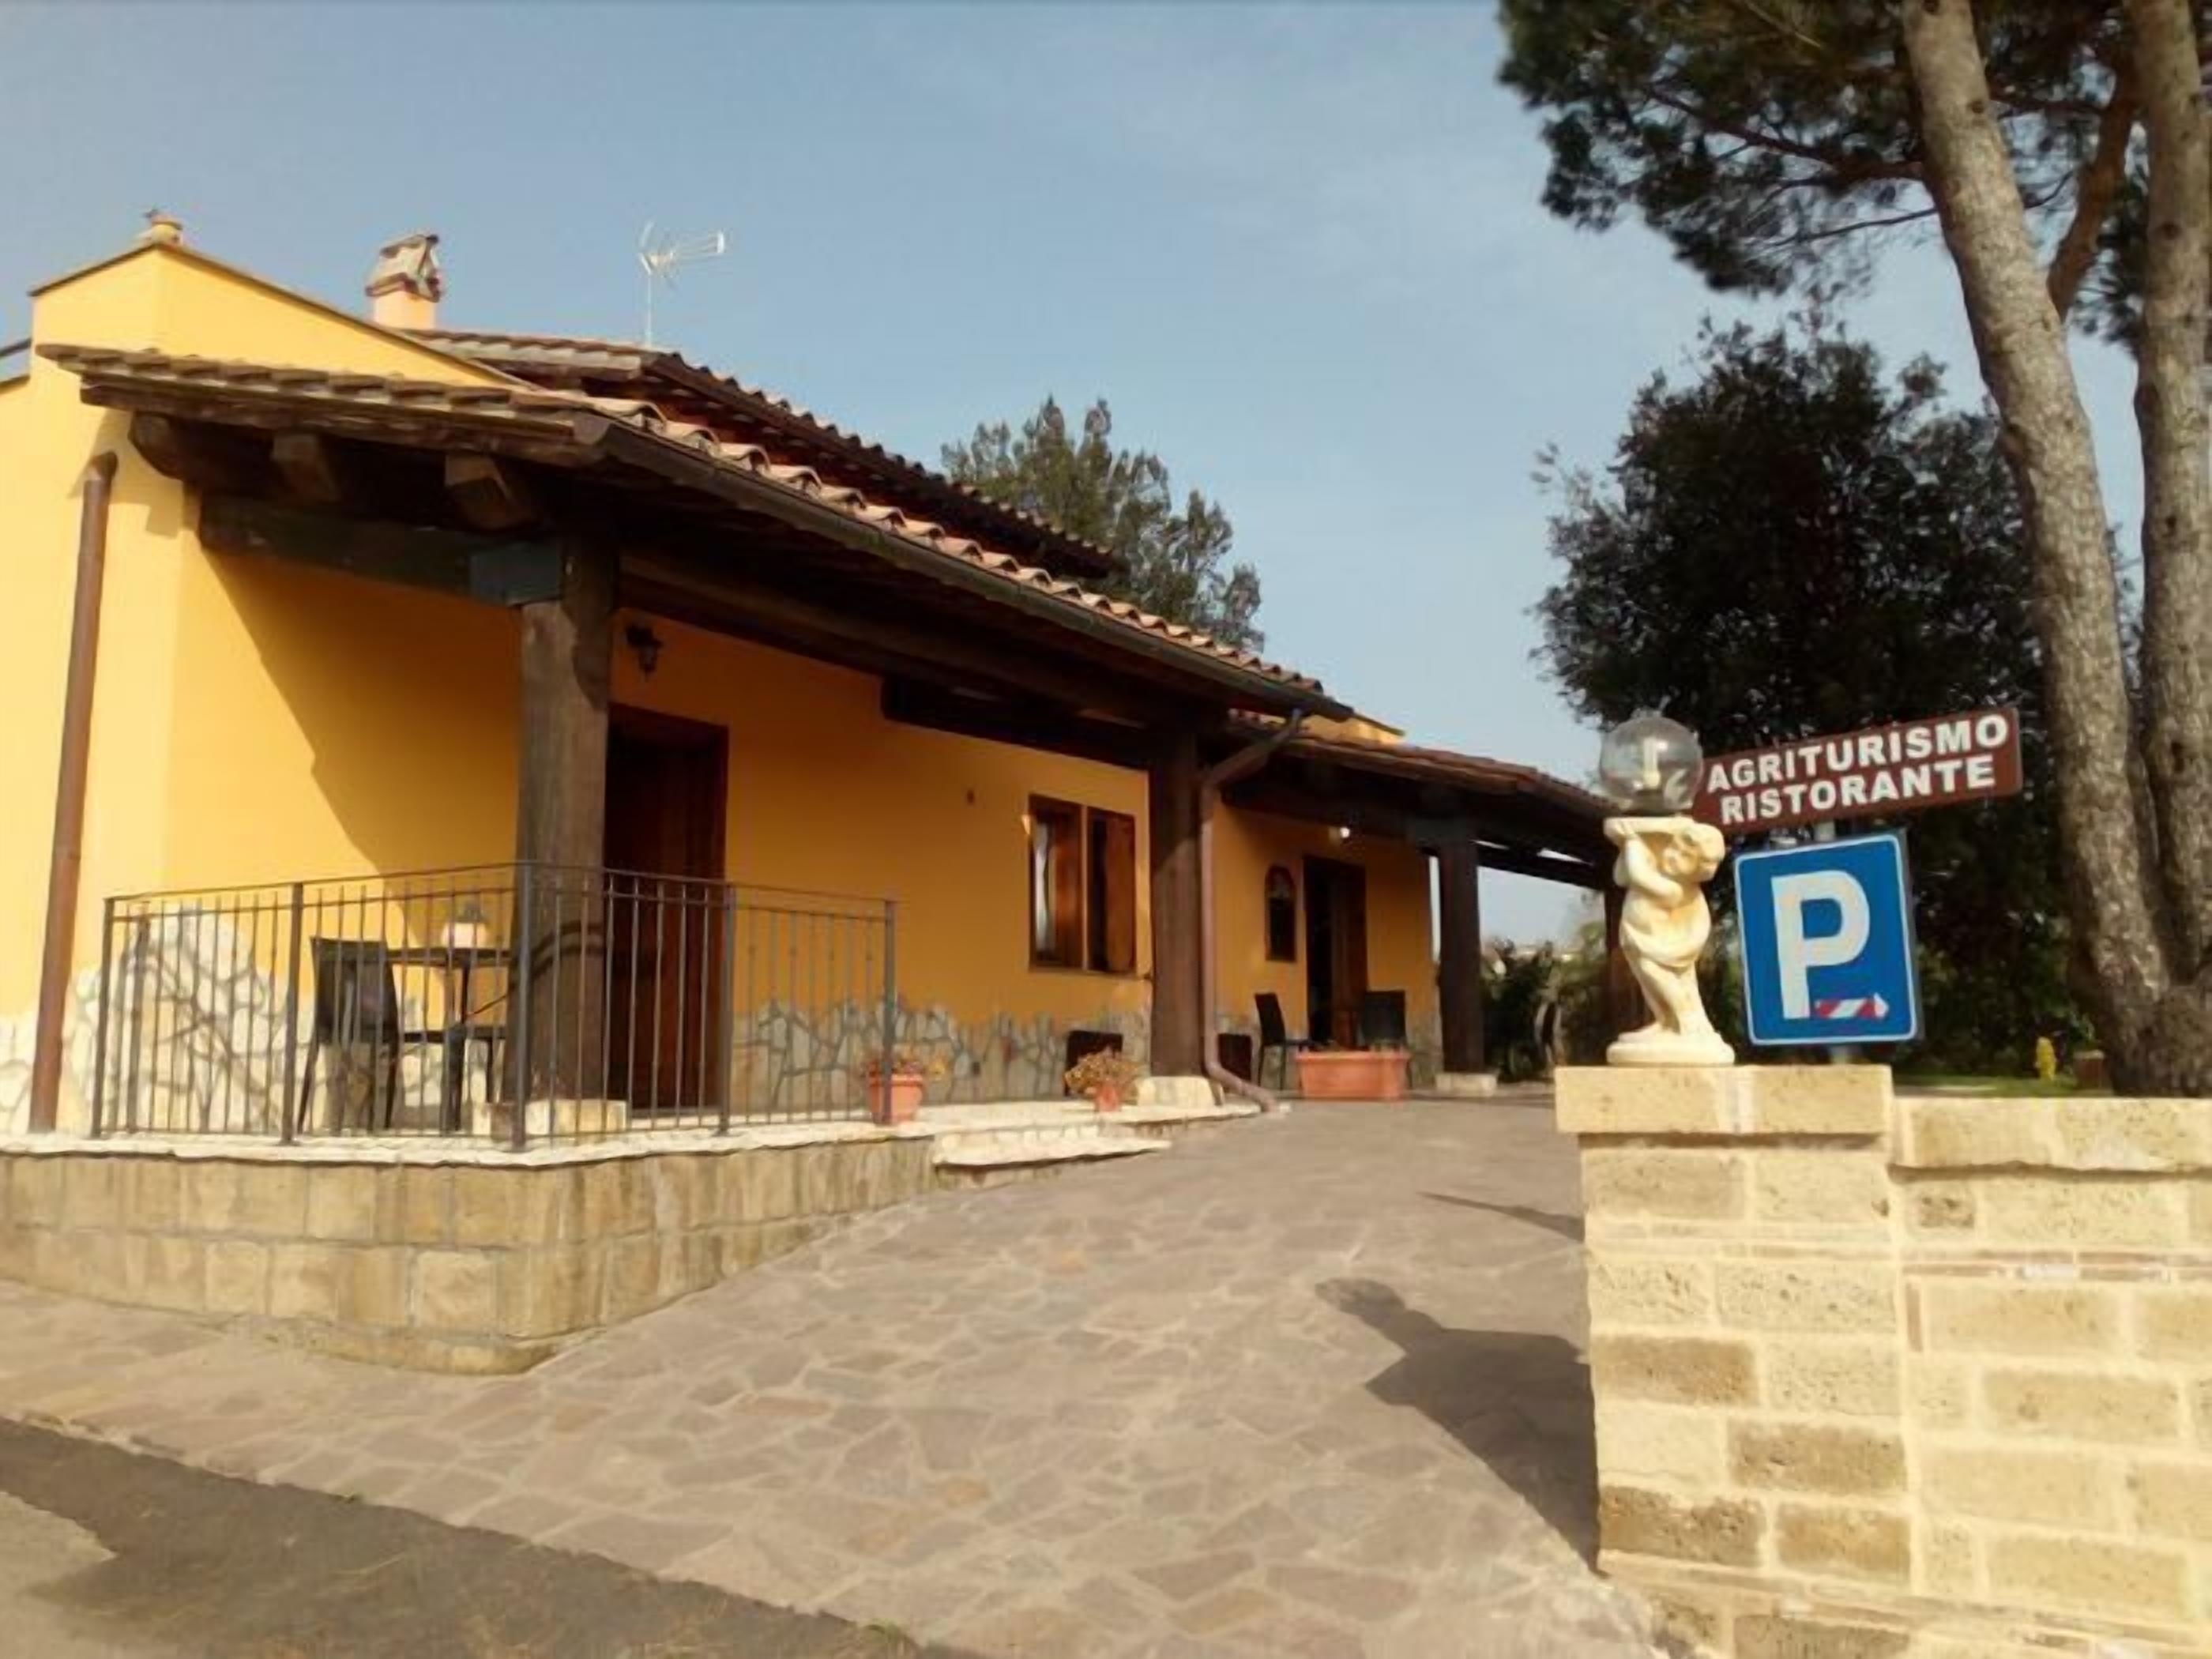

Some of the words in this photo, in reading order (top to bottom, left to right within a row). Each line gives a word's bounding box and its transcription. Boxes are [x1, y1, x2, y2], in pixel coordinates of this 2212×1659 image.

[1707, 714, 2008, 793] AGRITURISMO
[1721, 755, 1996, 825] RISTORANTE
[1771, 870, 1870, 1019] P
